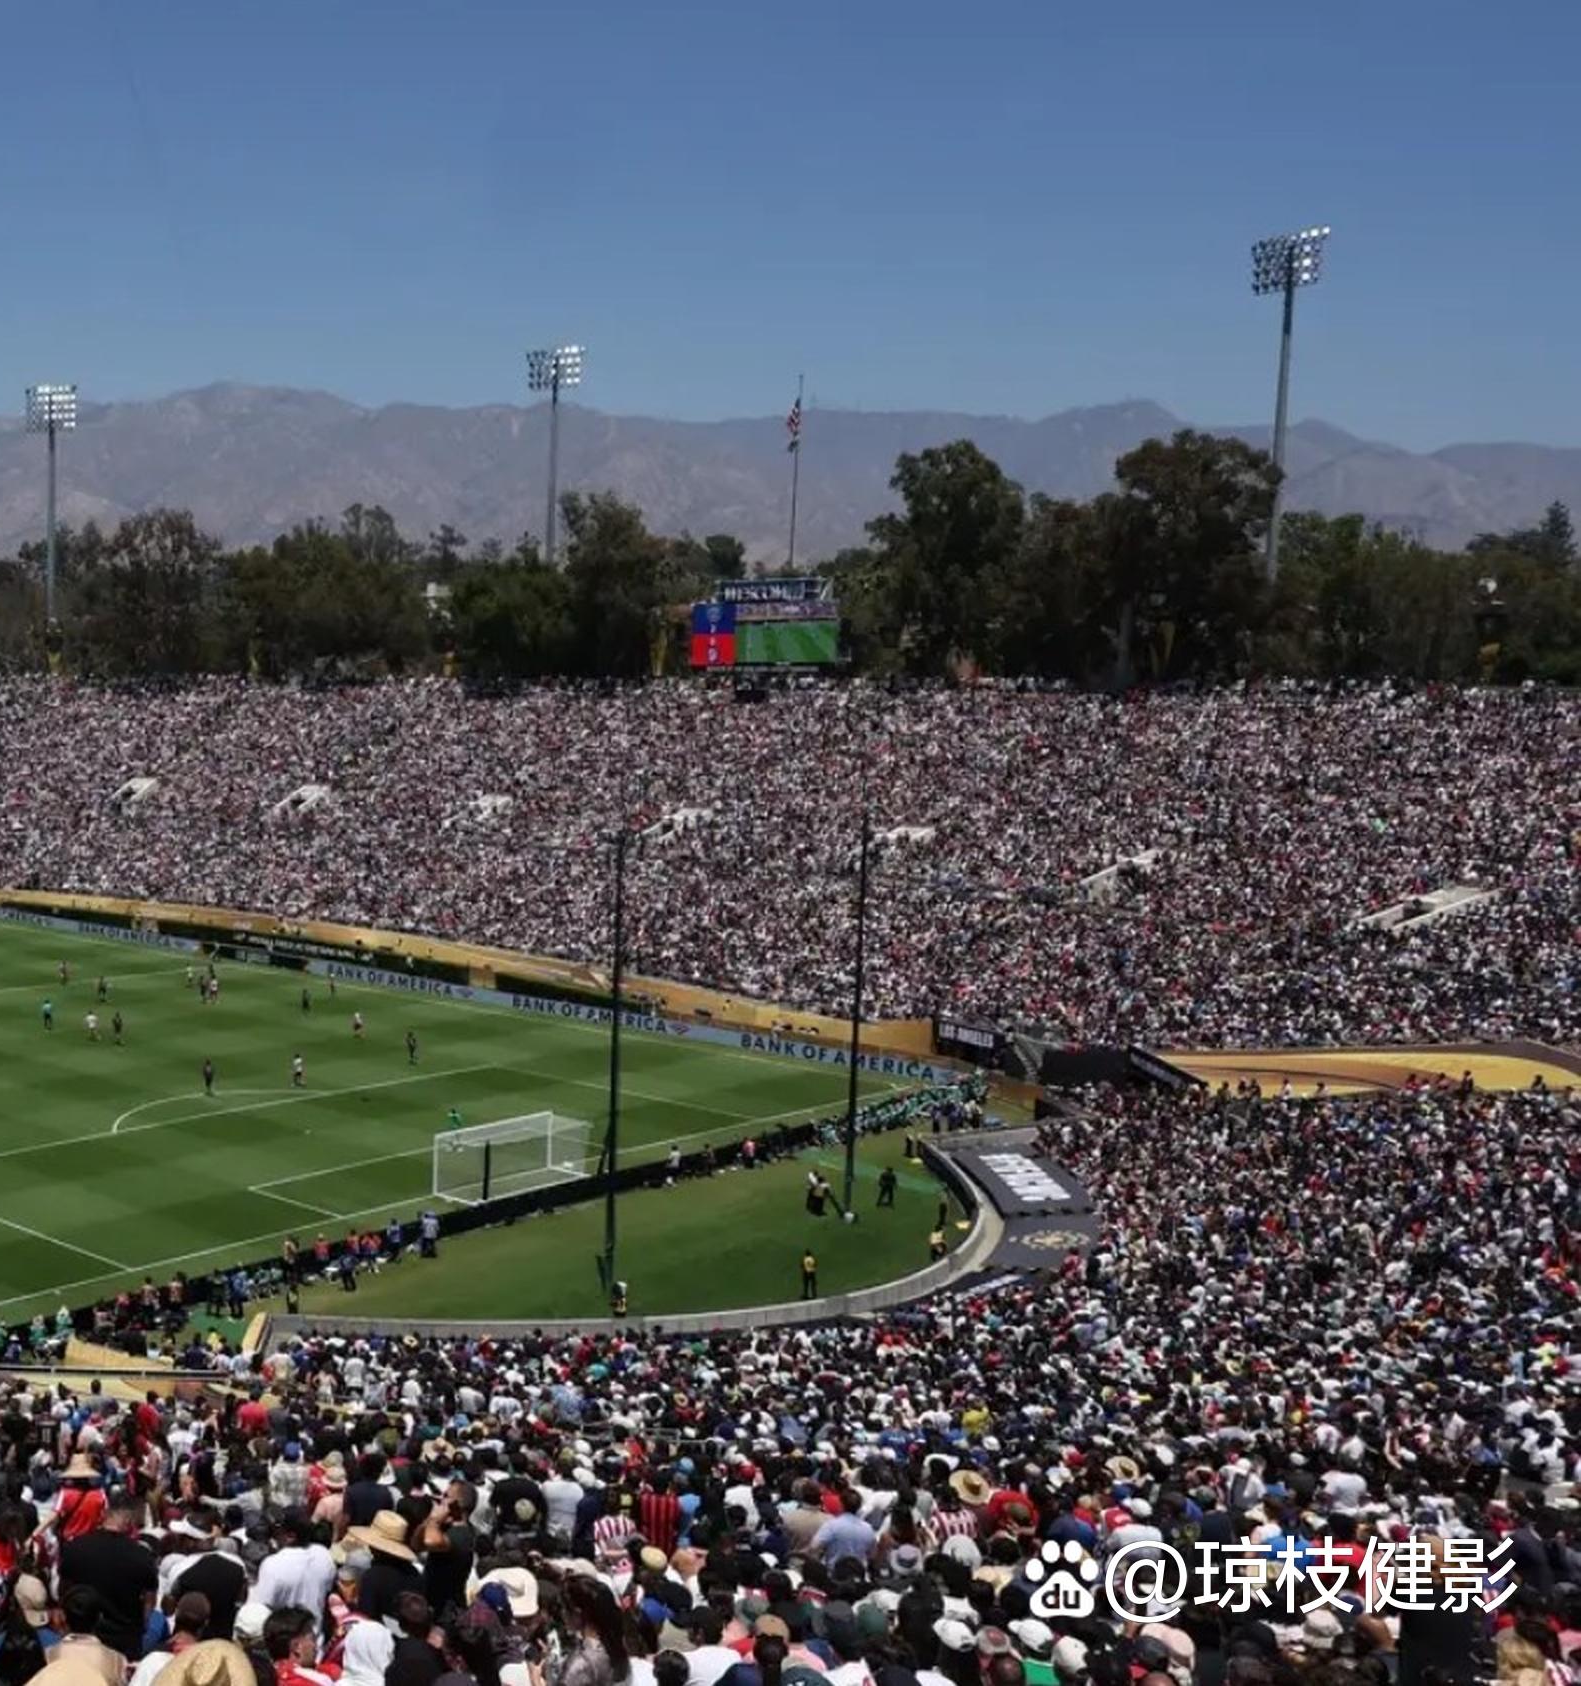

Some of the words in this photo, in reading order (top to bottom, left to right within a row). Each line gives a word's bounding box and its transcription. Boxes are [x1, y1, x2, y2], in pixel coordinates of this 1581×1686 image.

[327, 962, 363, 979] BANK
[387, 974, 452, 995] AMERICA
[512, 996, 556, 1014] BANK
[561, 1003, 581, 1017] OF
[740, 1032, 796, 1057] BANK
[802, 1045, 827, 1061] OF
